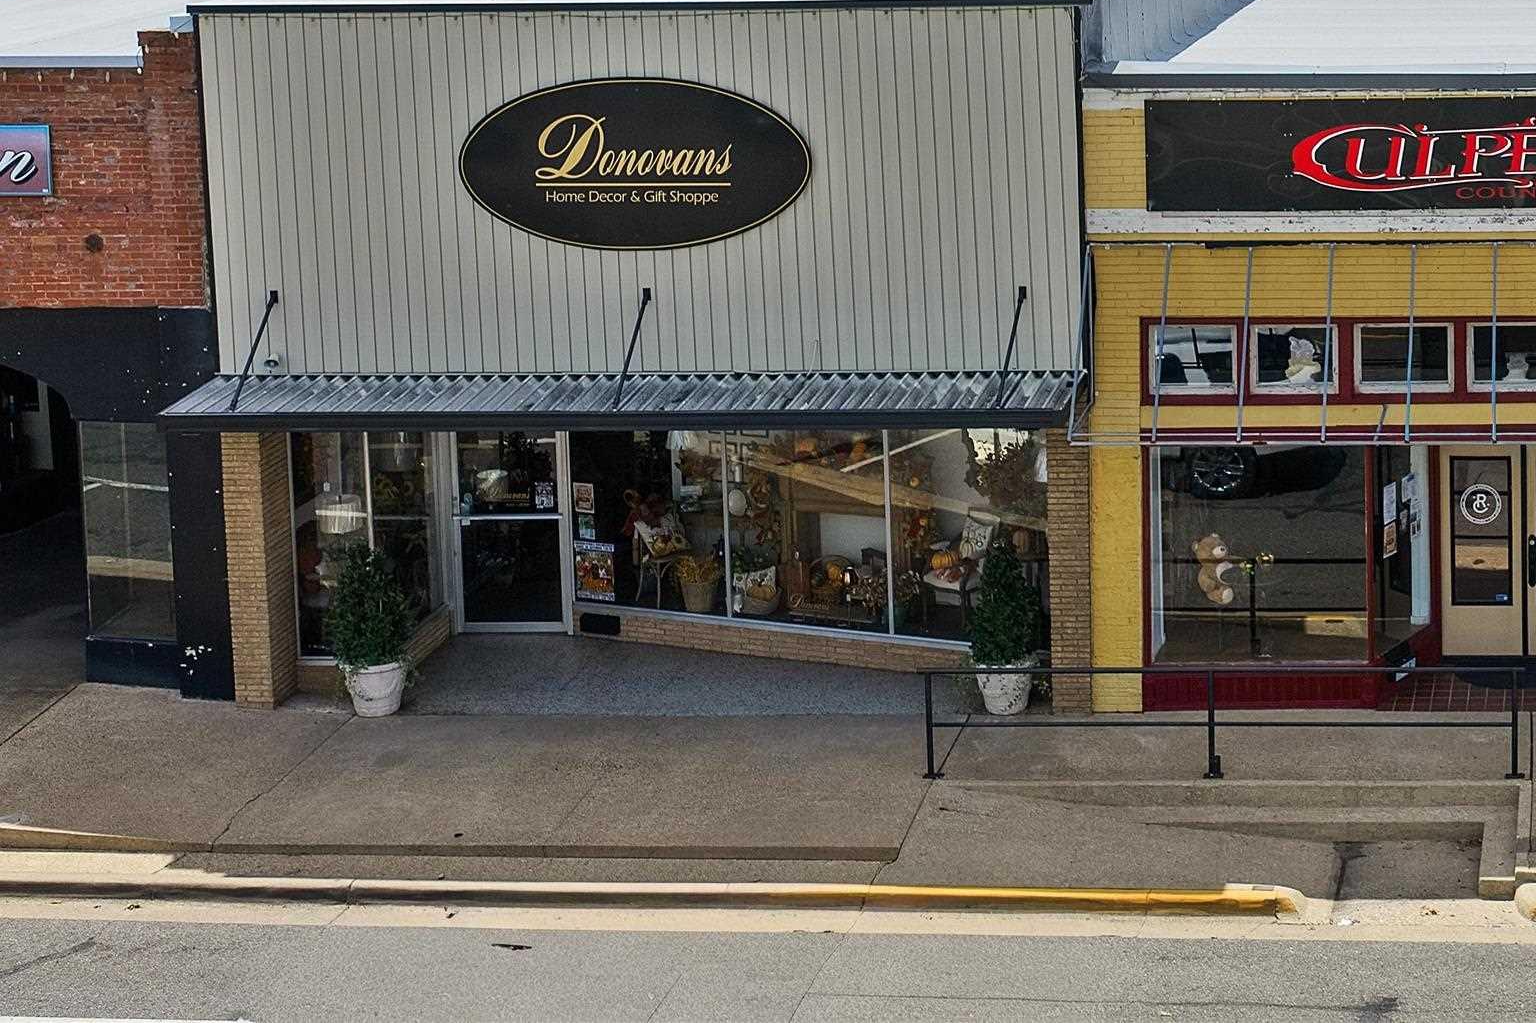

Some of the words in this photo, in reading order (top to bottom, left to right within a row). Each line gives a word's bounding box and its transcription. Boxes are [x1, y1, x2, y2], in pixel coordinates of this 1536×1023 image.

[535, 114, 732, 180] Donovans
[545, 190, 585, 203] Home
[588, 190, 628, 203] Decor
[630, 191, 641, 203] &
[644, 190, 667, 203] Gift
[669, 190, 719, 206] Shoppe
